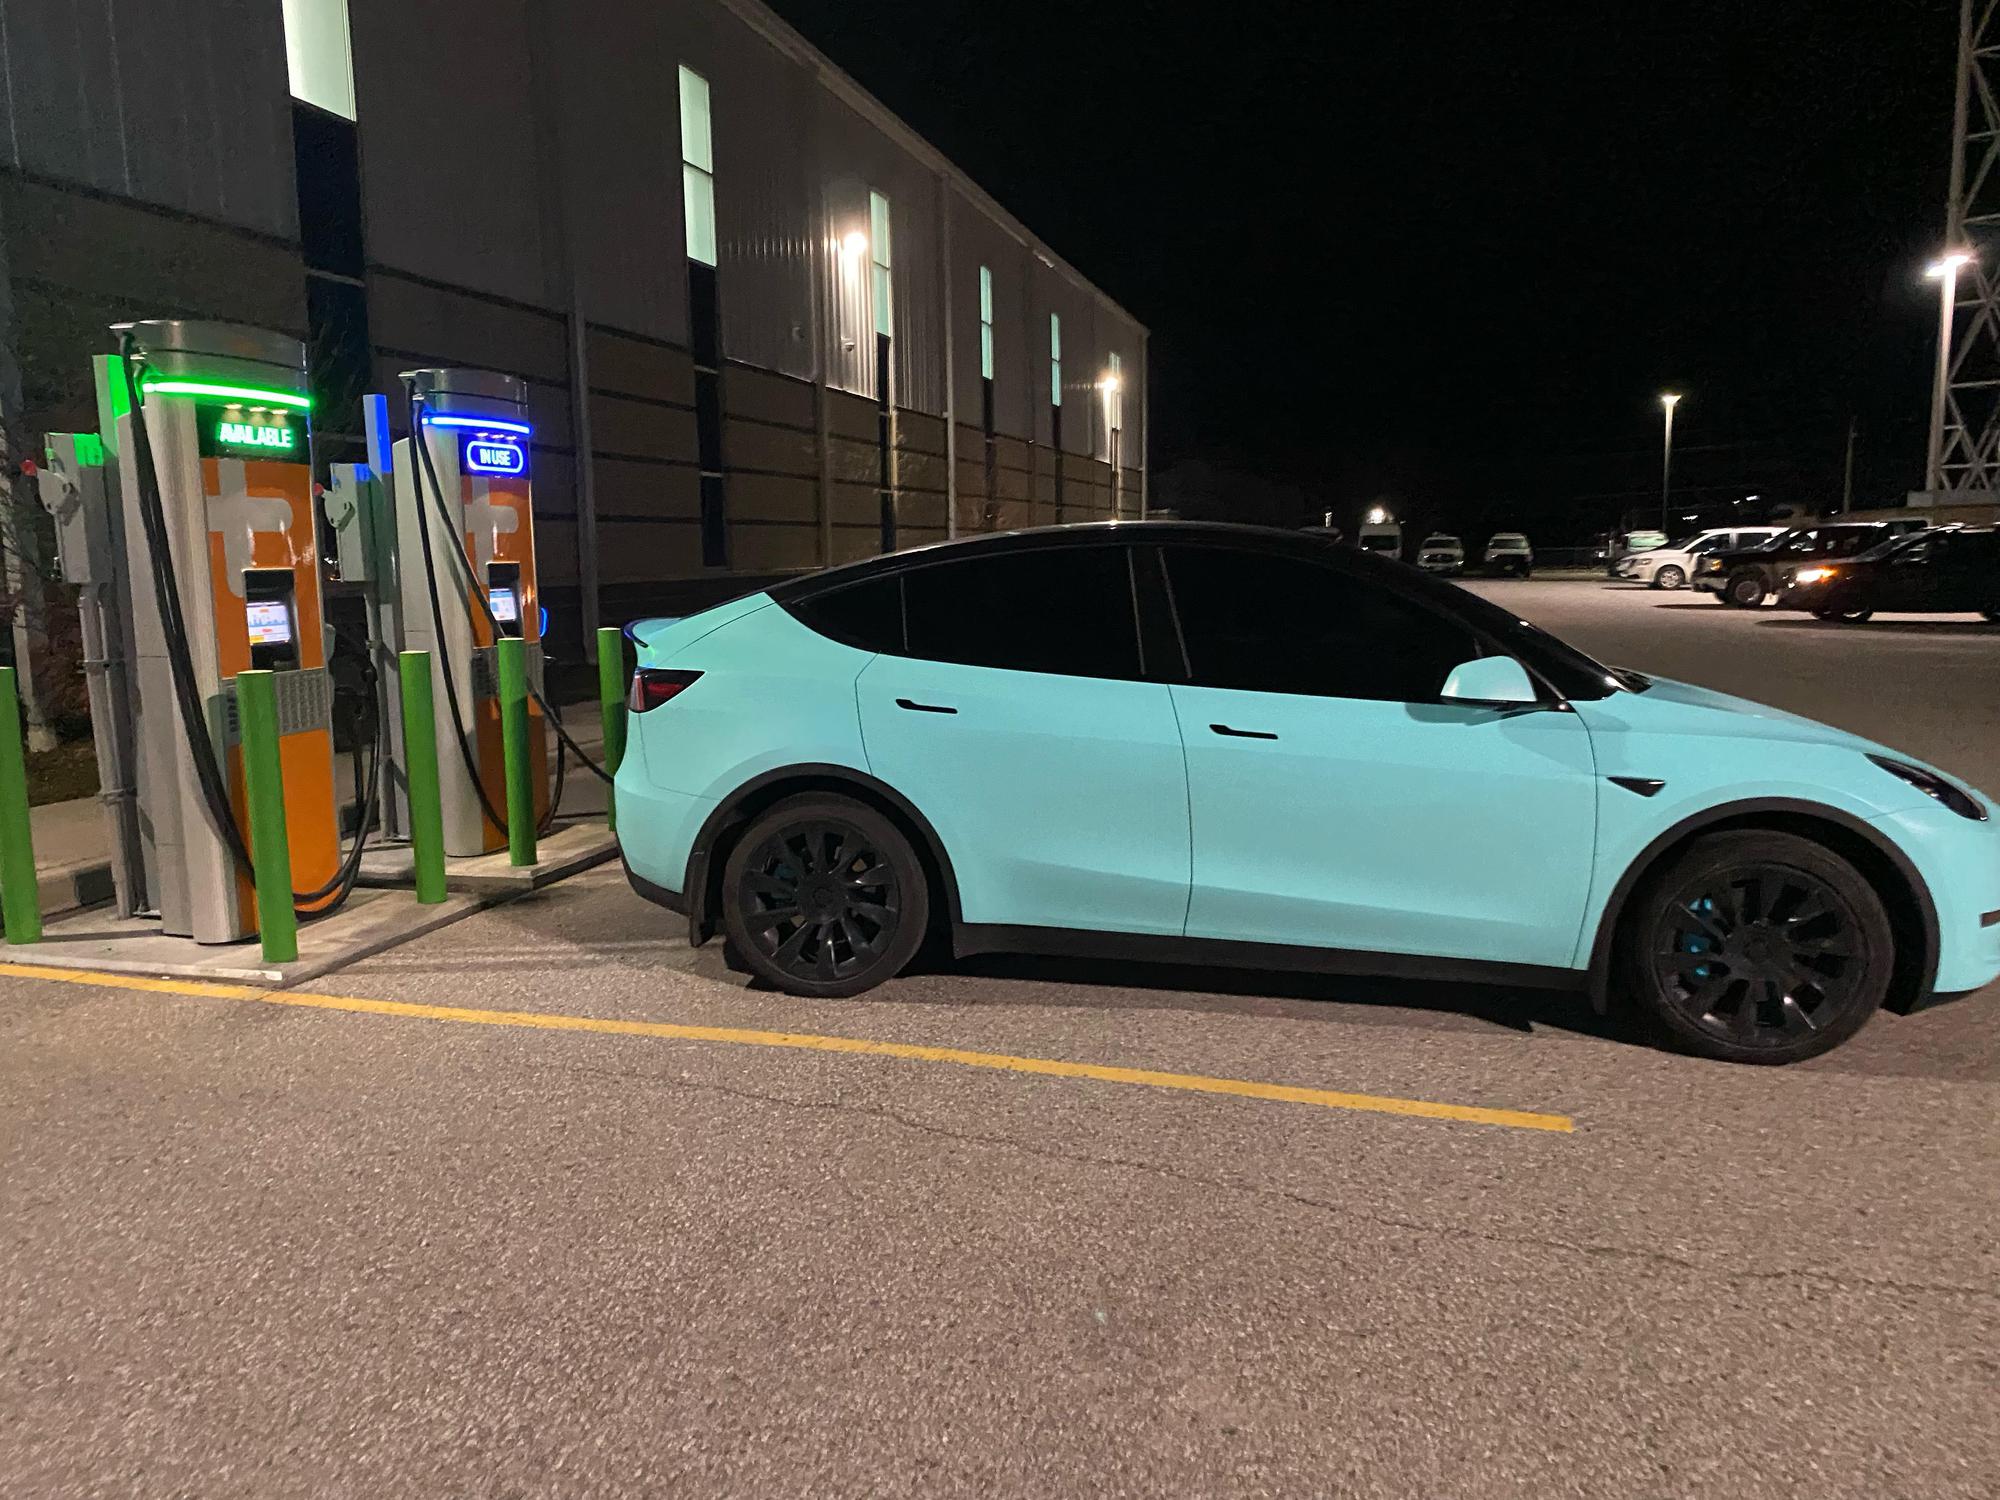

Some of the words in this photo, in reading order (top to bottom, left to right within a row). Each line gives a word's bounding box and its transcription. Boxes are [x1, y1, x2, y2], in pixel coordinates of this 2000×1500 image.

[219, 422, 293, 448] AVAILABLE
[479, 448, 492, 464] IN
[492, 450, 511, 466] USE
